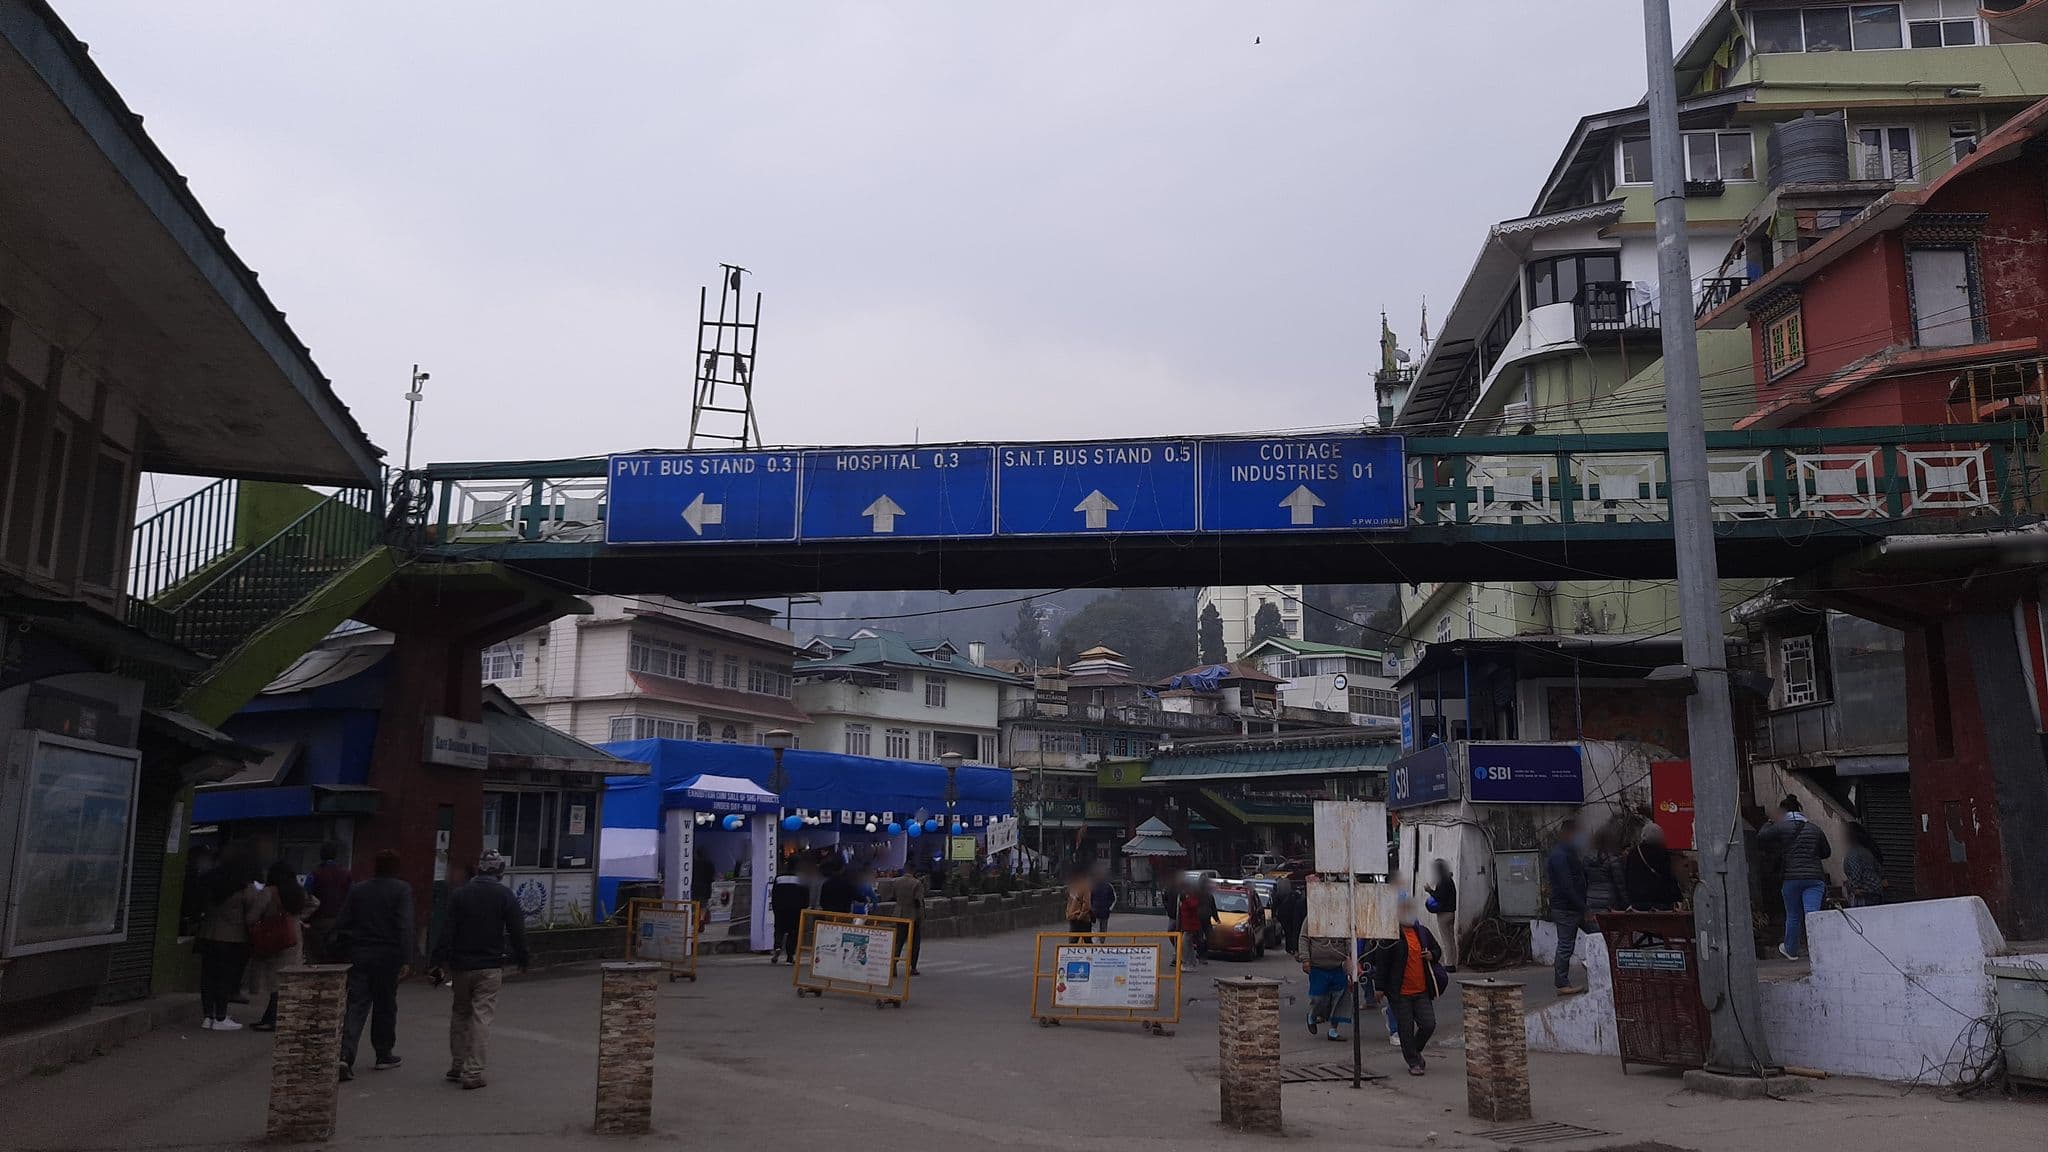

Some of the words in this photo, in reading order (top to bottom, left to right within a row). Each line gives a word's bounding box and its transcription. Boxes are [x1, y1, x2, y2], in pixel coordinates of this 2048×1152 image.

[836, 453, 921, 471] HOSPITAL
[934, 452, 960, 469] 0.3
[1005, 450, 1048, 467] S.N.T.
[1054, 449, 1088, 466] BUS
[1094, 447, 1152, 465] STAND
[1165, 446, 1191, 463] 0.5
[1260, 443, 1343, 461] COTTAGE
[617, 460, 653, 477] PVT.
[661, 459, 694, 476] BUS
[700, 457, 756, 475] STAND
[767, 456, 792, 473] 0.3
[1231, 463, 1340, 482] INDUSTRIES
[1352, 462, 1374, 479] 01
[1395, 766, 1409, 799] SBI
[1489, 766, 1512, 781] SBI
[1066, 947, 1087, 955] NO
[1091, 947, 1151, 955] PARKING
